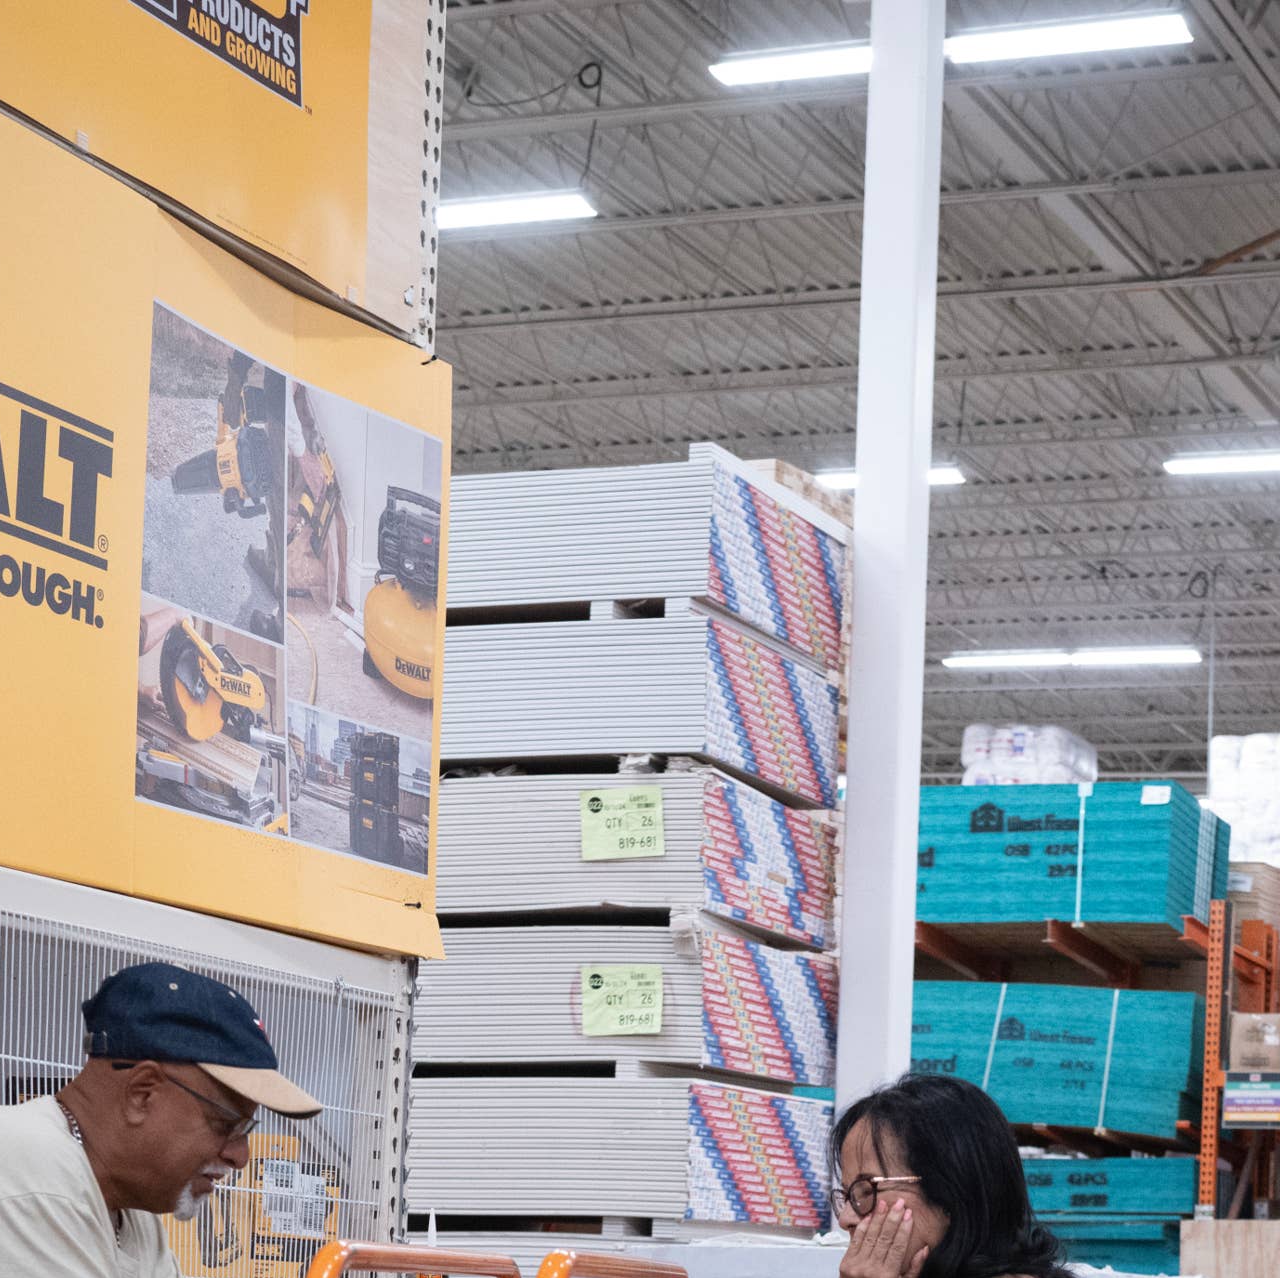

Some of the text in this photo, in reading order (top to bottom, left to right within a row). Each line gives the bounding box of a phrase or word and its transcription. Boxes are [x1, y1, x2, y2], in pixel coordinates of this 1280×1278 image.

[188, 0, 296, 67] RODUCTS
[187, 7, 297, 95] AND GROWING
[395, 657, 431, 681] DEWALT
[220, 677, 252, 696] DEWALT
[605, 815, 653, 829] QTY 26
[619, 836, 656, 849] 819-681
[606, 993, 653, 1005] QTY 26
[619, 1013, 655, 1025] 819-681
[910, 1054, 957, 1073] oard
